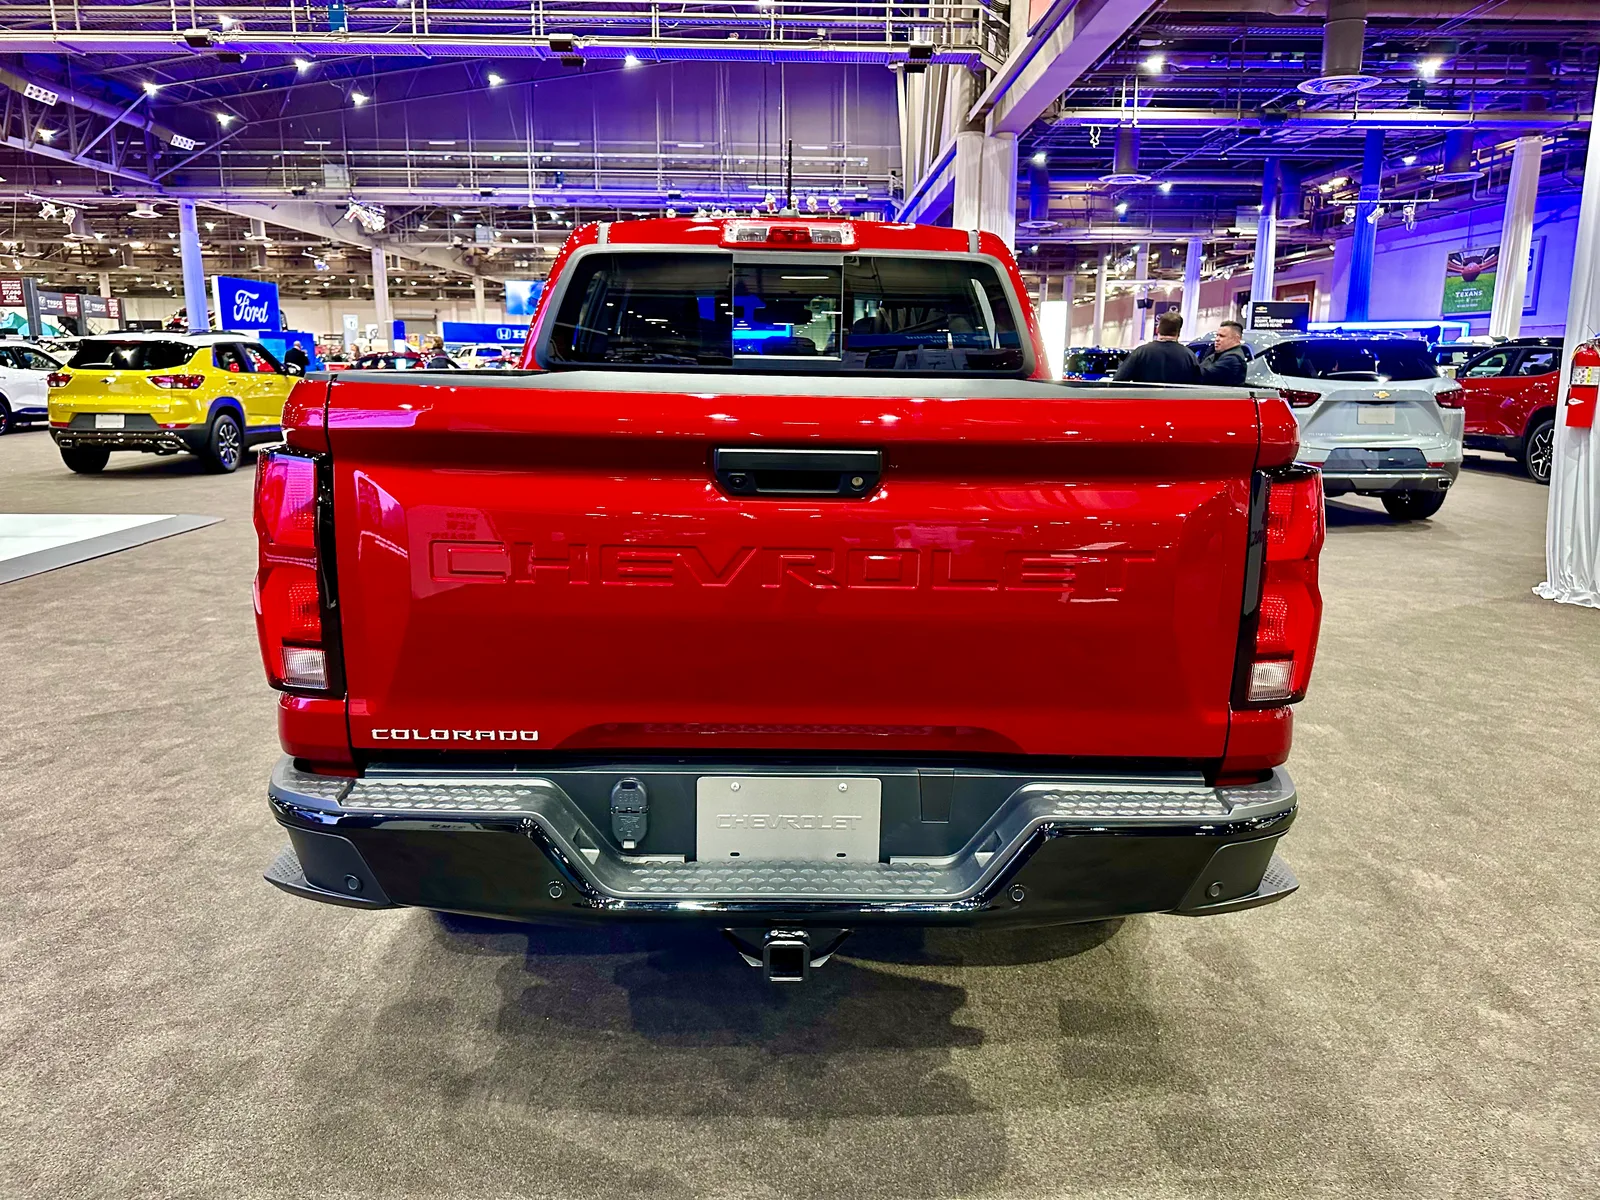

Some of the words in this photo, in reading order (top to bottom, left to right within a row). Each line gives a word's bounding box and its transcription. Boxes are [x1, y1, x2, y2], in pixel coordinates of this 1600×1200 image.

[1455, 290, 1483, 298] TEXANS
[233, 289, 269, 323] Ford
[429, 539, 1157, 593] CHEVROLET
[371, 728, 540, 742] COLORADO
[715, 813, 863, 831] CHEVROLET
